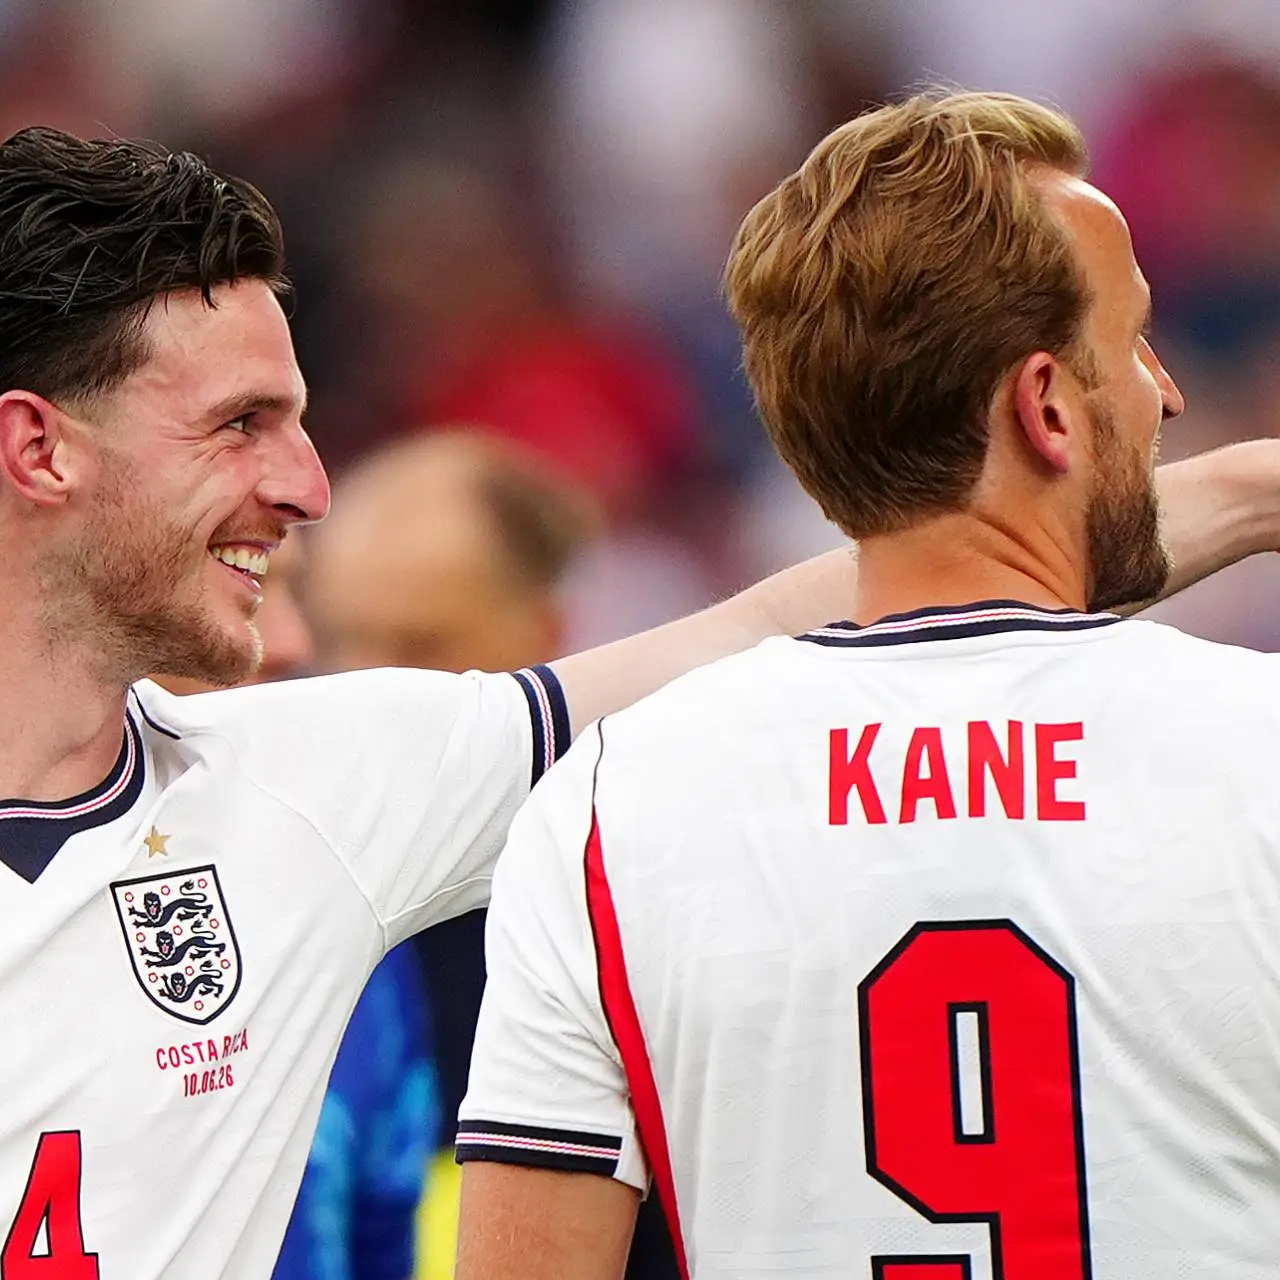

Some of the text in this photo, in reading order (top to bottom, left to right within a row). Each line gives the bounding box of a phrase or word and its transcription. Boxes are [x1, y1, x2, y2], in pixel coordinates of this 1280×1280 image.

[828, 719, 1086, 825] KANE
[156, 1039, 218, 1070] COSTA
[183, 1064, 234, 1097] 10.06.26
